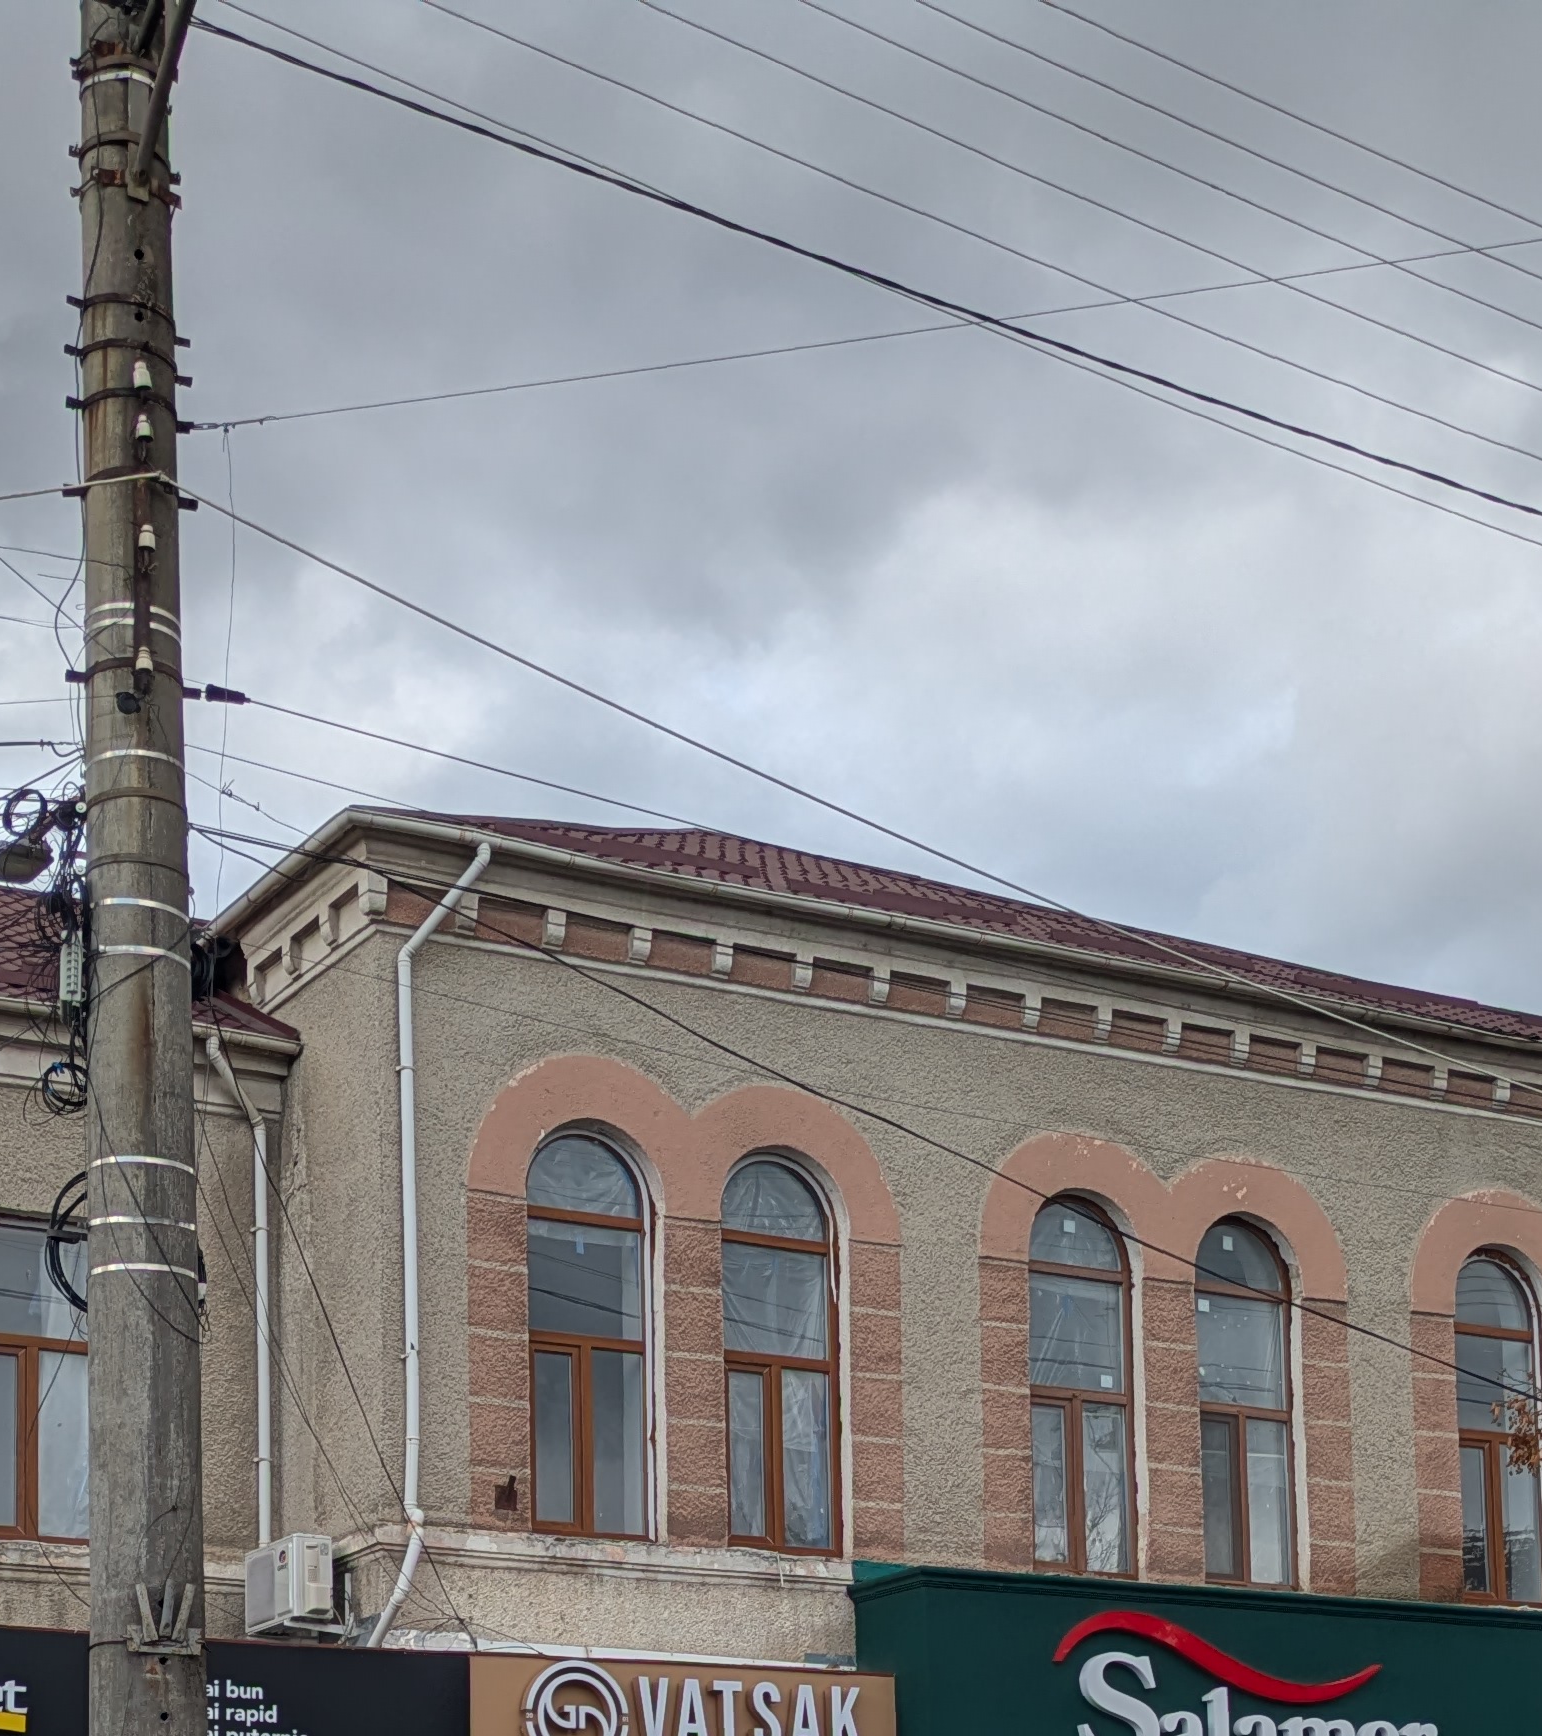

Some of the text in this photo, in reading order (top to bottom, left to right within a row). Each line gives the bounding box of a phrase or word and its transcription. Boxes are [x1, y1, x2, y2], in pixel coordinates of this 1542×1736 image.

[206, 1679, 263, 1699] ai bun
[207, 1702, 278, 1727] ai rapid
